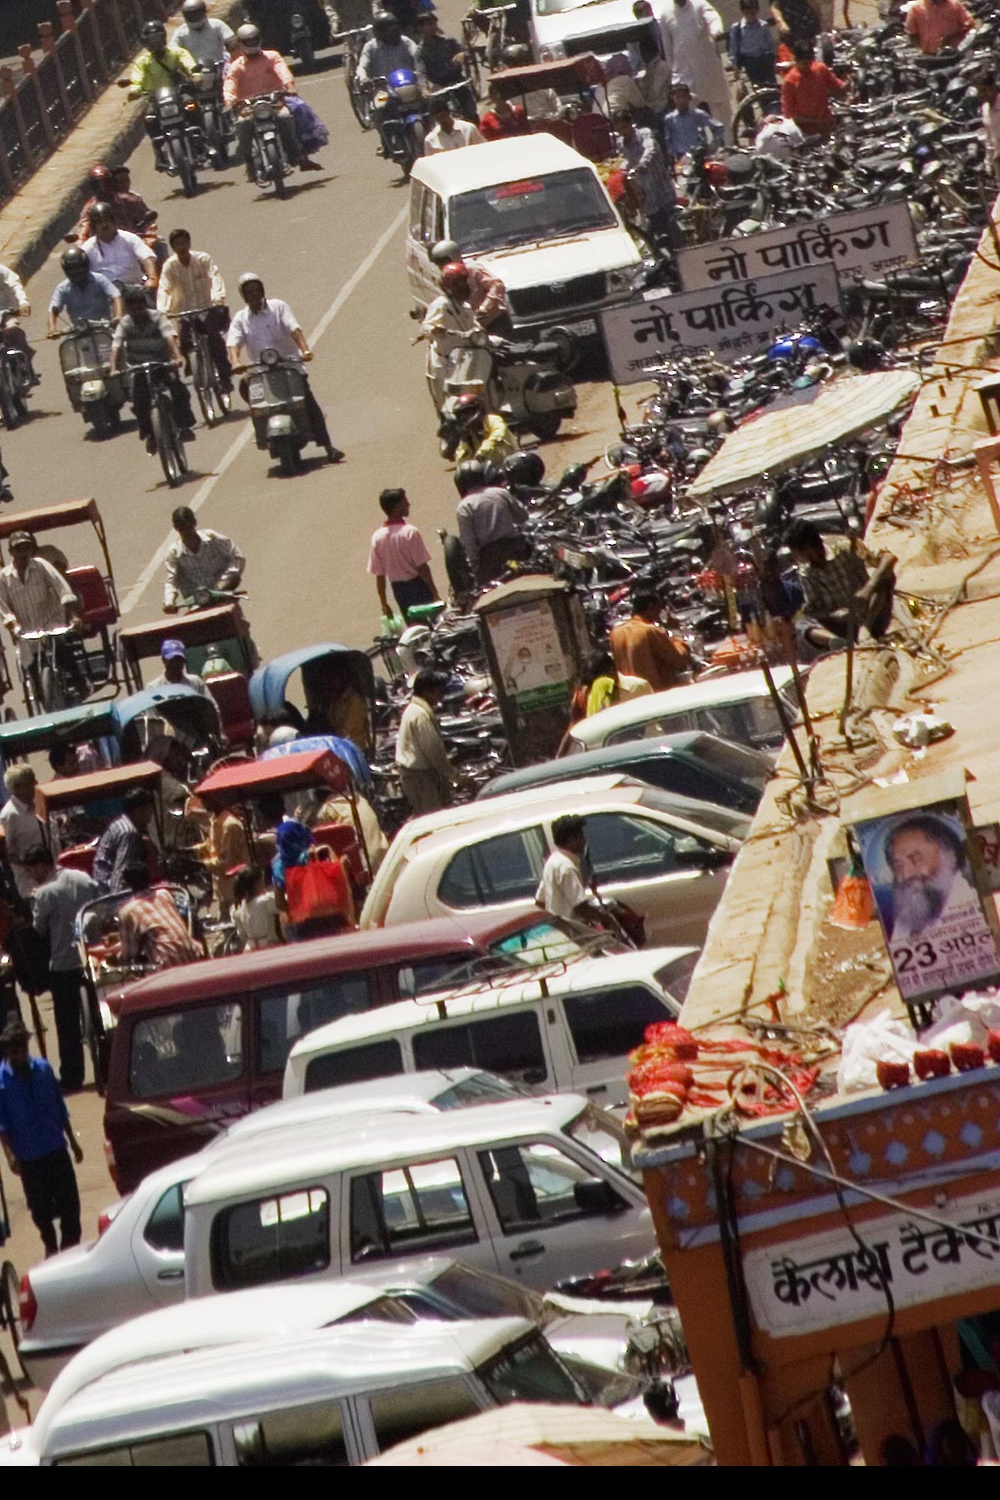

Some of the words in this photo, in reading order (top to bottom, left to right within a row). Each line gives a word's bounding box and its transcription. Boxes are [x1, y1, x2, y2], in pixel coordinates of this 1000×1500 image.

[704, 246, 748, 282] नो
[755, 222, 890, 268] पार्किंग
[630, 304, 675, 343] नो
[679, 283, 817, 332] पार्किंग
[893, 941, 937, 973] 23
[772, 1241, 893, 1306] कैलाश
